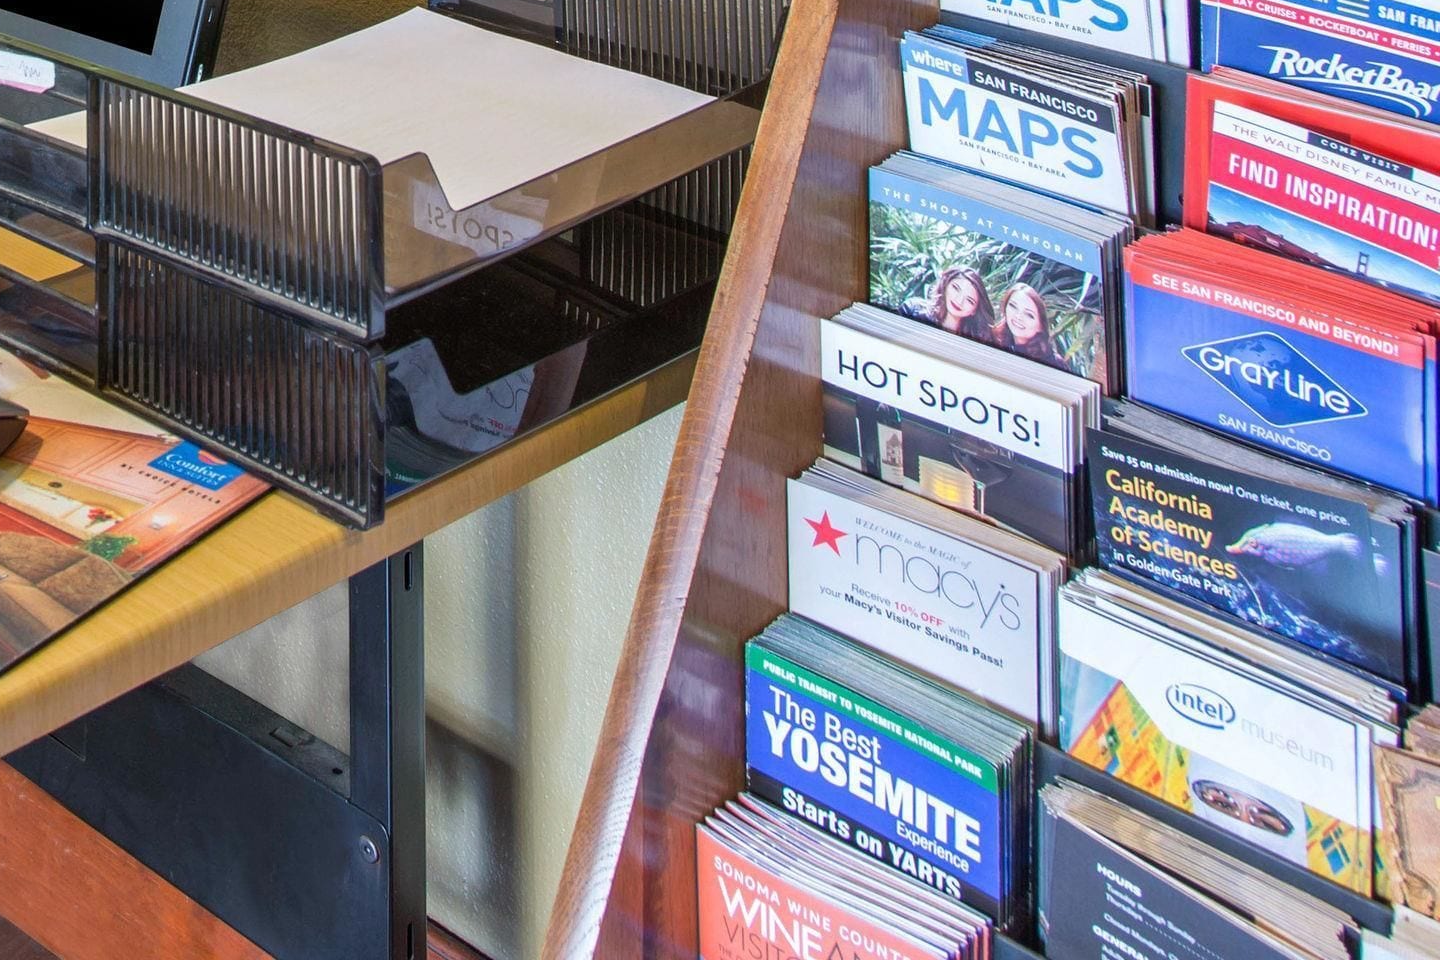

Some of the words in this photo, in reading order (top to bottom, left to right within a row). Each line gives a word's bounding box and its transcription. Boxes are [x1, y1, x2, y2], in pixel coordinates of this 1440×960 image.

[986, 5, 1002, 15] SAN
[1004, 8, 1046, 24] FRANCISCO
[1054, 20, 1069, 30] BAY
[1072, 24, 1092, 36] AREA
[1256, 1, 1297, 20] CRUISES
[1309, 16, 1380, 42] ROCKETBOAT
[1391, 38, 1431, 56] FERRIES
[1378, 6, 1406, 24] SAN
[912, 48, 964, 76] where
[975, 70, 1007, 92] SAN
[1010, 82, 1098, 123] FRANCISCO
[918, 76, 1104, 179] MAPS
[1320, 138, 1358, 158] COME
[1362, 153, 1401, 172] VISIT
[958, 138, 974, 149] SAN
[976, 144, 1020, 163] FRANCISCO
[1028, 160, 1043, 172] BAY
[1046, 166, 1066, 178] AREA
[1232, 123, 1258, 140] THE
[1262, 133, 1302, 154] WALT
[1306, 145, 1360, 176] DISNEY
[1366, 171, 1420, 198] FAMILY
[884, 187, 911, 202] THE
[920, 198, 968, 220] SHOPS
[977, 218, 994, 230] AT
[1002, 225, 1084, 262] TANFORAN
[1228, 153, 1278, 188] FIND
[1286, 174, 1439, 250] INSPIRATION!
[1152, 274, 1180, 292] SEE
[1182, 280, 1211, 300] SAN
[1214, 289, 1296, 324] FRANCISCO
[1298, 315, 1330, 335] AND
[1332, 326, 1400, 357] BEYOND!
[837, 348, 908, 396] HOT
[918, 379, 1041, 448] SPOTS!
[1218, 413, 1247, 434] SAN
[1250, 422, 1332, 462] FRANCISCO
[166, 453, 228, 482] Comfort
[1100, 445, 1125, 464] Save
[1126, 454, 1138, 469] $5
[1140, 459, 1152, 471] on
[1155, 462, 1207, 488] admission
[1208, 478, 1234, 496] now!
[1236, 485, 1258, 502] One
[1295, 503, 1317, 518] one
[1319, 510, 1351, 530] price.
[1106, 468, 1213, 520] California
[854, 516, 904, 541] WELCOME
[904, 536, 913, 545] to
[913, 538, 926, 551] the
[928, 544, 960, 564] MAGIC
[961, 559, 972, 571] of
[1109, 496, 1213, 549] Academy
[1112, 524, 1134, 547] of
[1138, 532, 1238, 580] Sciences
[1113, 549, 1125, 563] in
[1126, 552, 1168, 578] Golden
[1171, 568, 1202, 588] Gate
[1204, 578, 1232, 598] Park
[819, 584, 842, 600] your
[844, 593, 884, 616] Macy's
[886, 608, 922, 631] Visitor
[925, 624, 970, 652] Savings
[972, 648, 1004, 668] Pass!
[850, 582, 892, 606] Receive
[894, 601, 919, 618] 10%
[948, 624, 970, 640] with
[762, 660, 797, 683] PUBLIC
[798, 676, 838, 702] TRANSIT
[840, 694, 852, 710] TO
[854, 702, 903, 736] YOSEMITE
[904, 728, 953, 763] NATIONAL
[954, 754, 983, 779] PARK
[768, 684, 816, 730] The
[824, 711, 882, 765] Best
[1174, 684, 1223, 721] intel
[1240, 716, 1336, 772] museum
[762, 709, 981, 864] YOSEMITE
[782, 786, 850, 840] Starts
[856, 830, 884, 859] on
[889, 840, 962, 900] YARTS
[896, 820, 970, 874] Experience
[714, 856, 781, 906] SONOMA
[787, 898, 832, 932] WINE
[1096, 862, 1142, 898] HOURS
[718, 875, 822, 960] WINE
